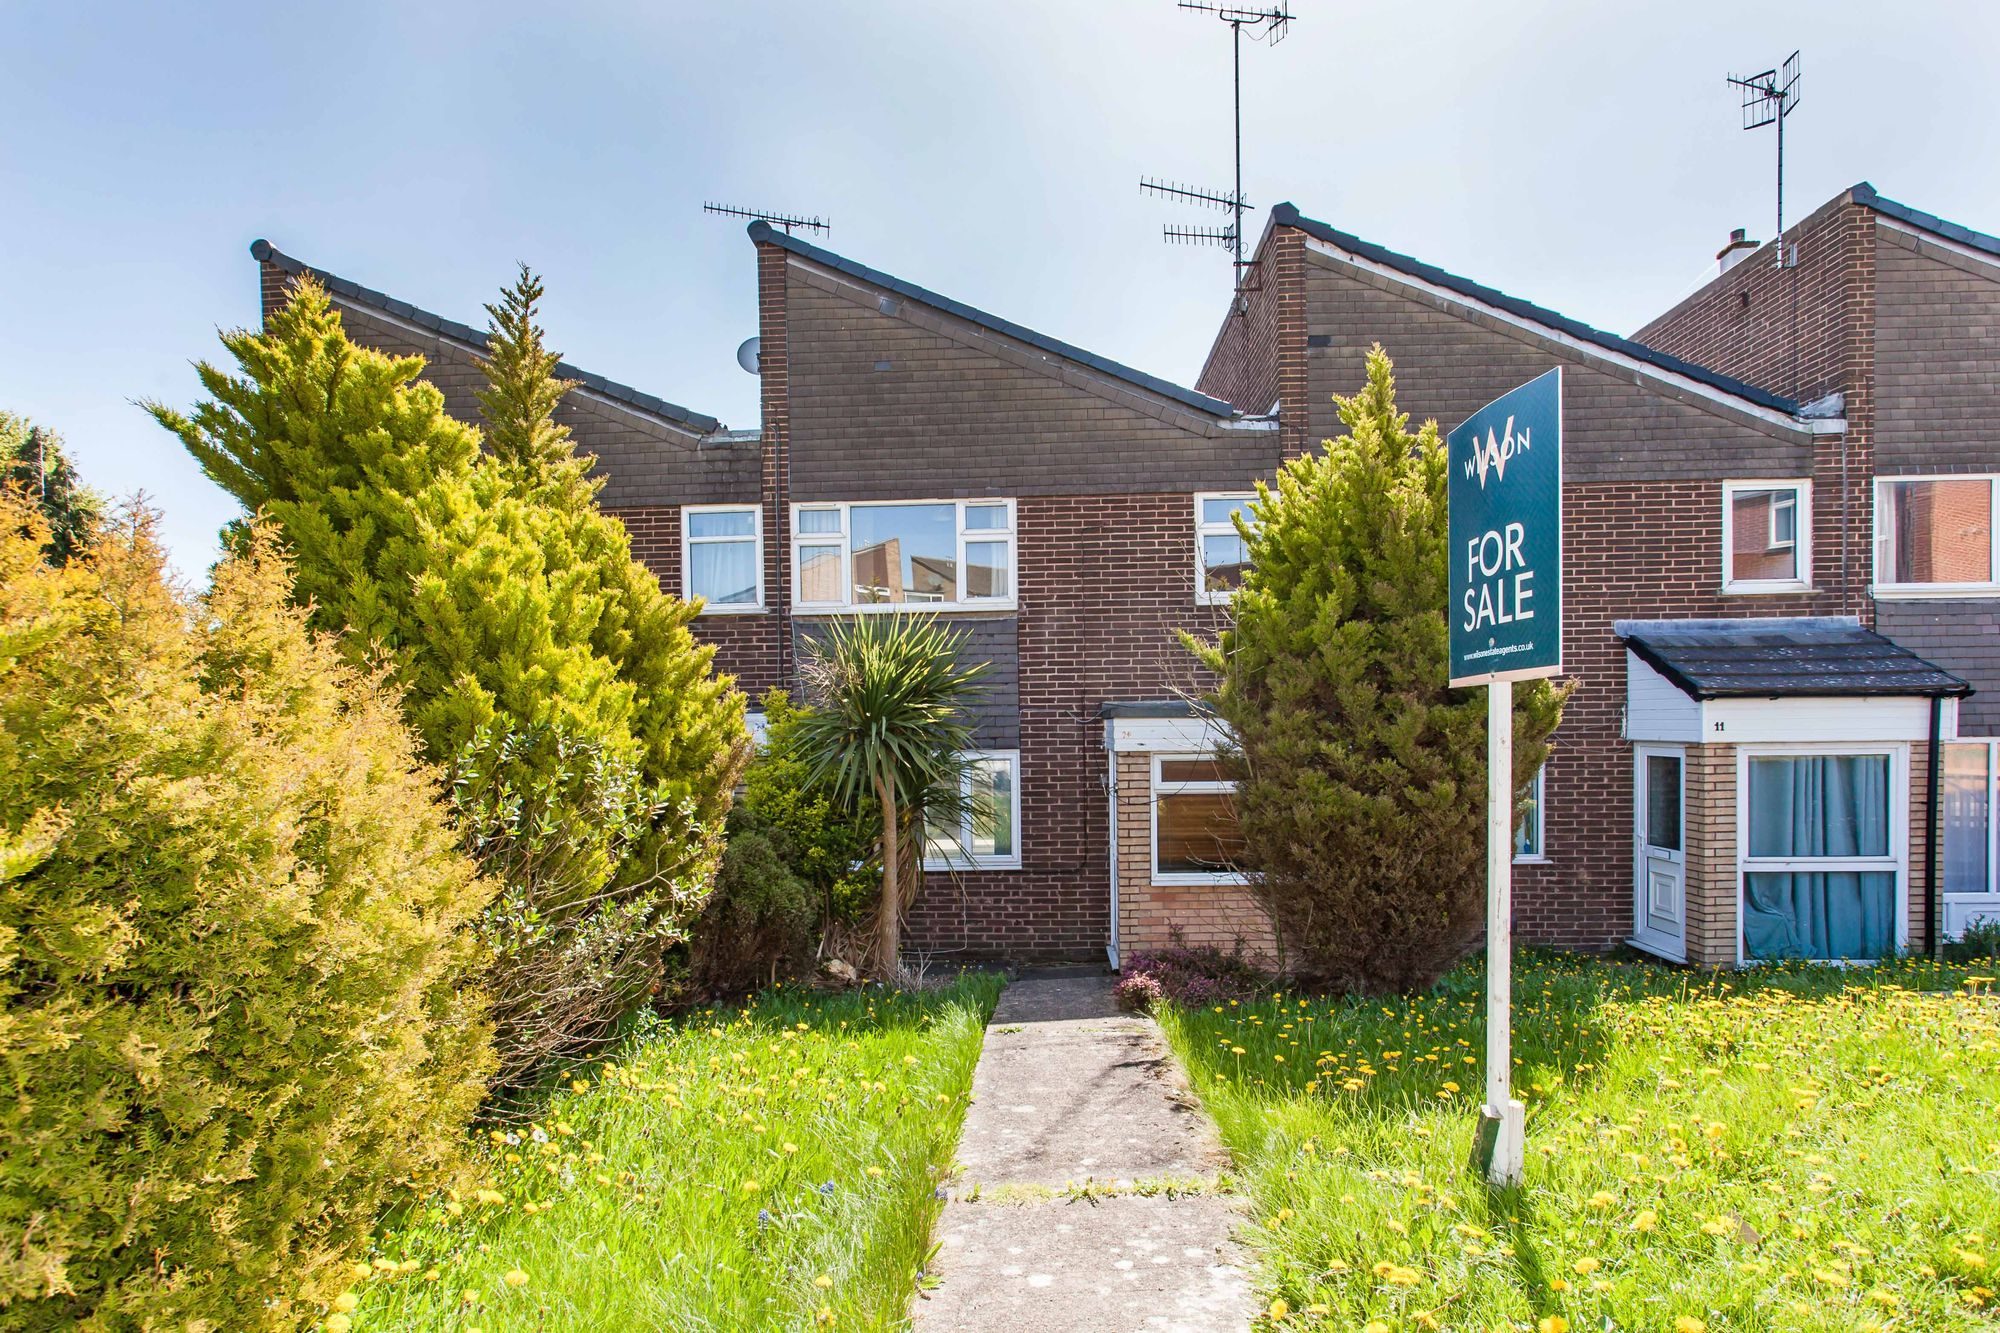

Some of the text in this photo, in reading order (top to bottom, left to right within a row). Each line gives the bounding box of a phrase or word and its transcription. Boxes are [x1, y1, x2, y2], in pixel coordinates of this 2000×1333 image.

[1468, 522, 1526, 583] FOR
[1463, 571, 1535, 633] SALE
[1714, 721, 1725, 731] 11
